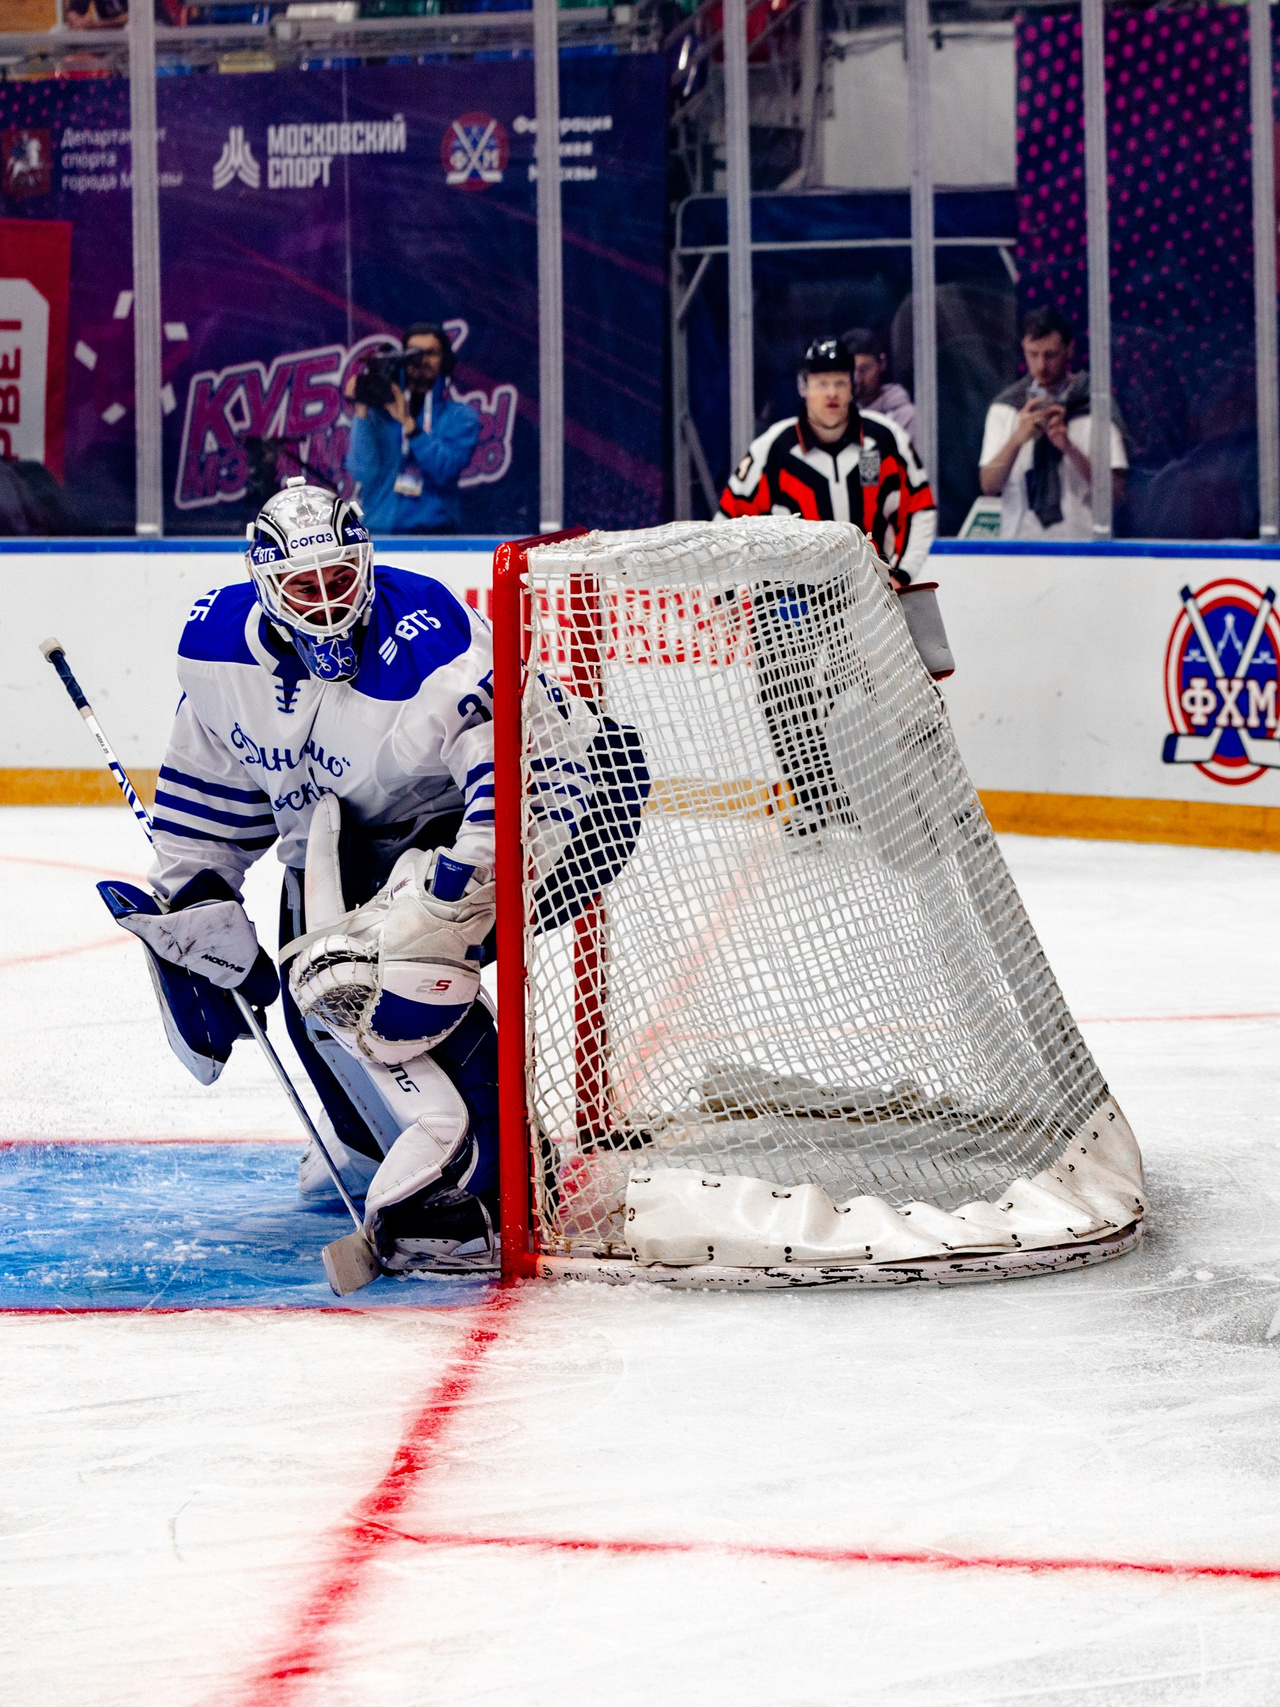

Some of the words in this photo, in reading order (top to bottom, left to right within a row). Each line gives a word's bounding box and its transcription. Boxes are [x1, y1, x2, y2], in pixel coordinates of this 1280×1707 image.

[268, 112, 406, 156] МОСКОВСКИЙ
[268, 156, 334, 189] СПОРТ
[290, 532, 334, 550] согаз
[1180, 676, 1279, 728] ФХМ
